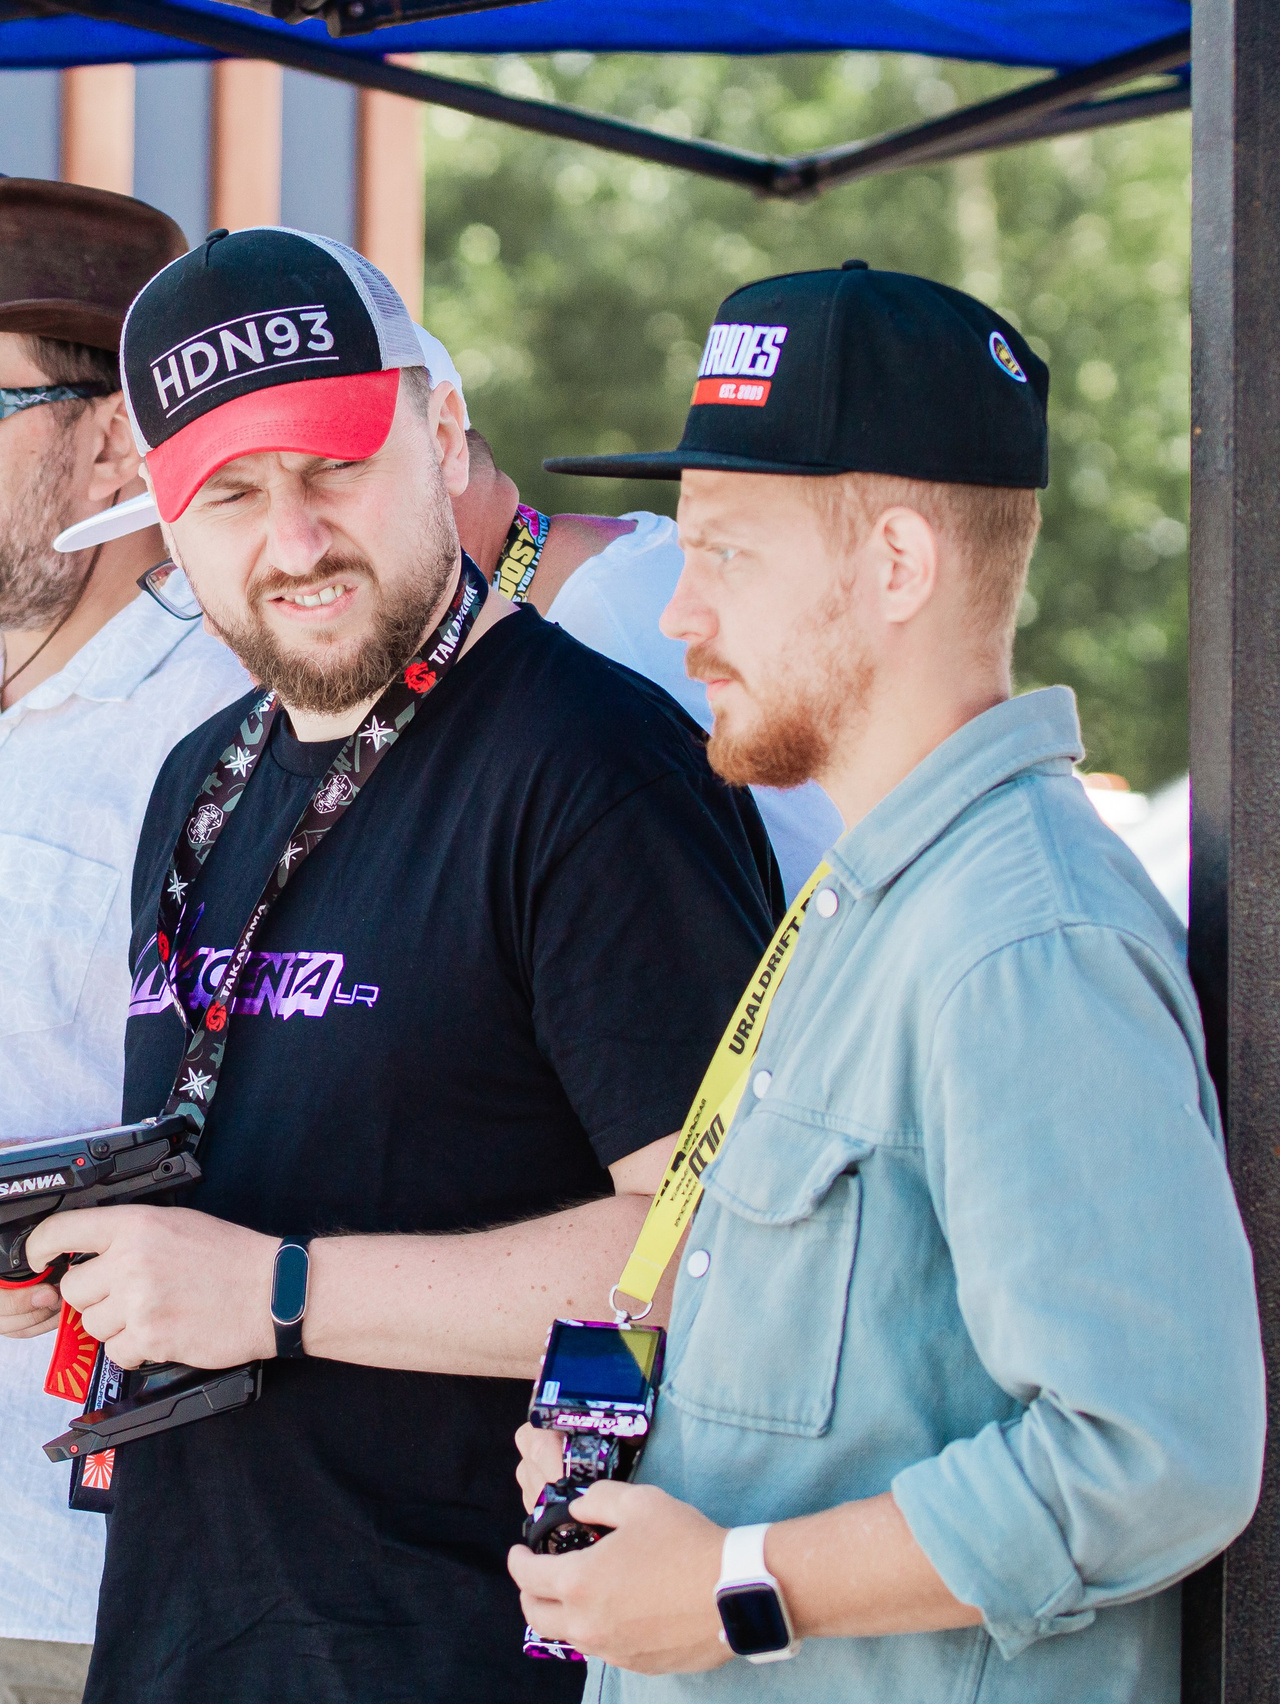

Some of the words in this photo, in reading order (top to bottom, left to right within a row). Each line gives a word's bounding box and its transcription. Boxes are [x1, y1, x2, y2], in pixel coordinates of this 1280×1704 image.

[152, 311, 335, 410] HDN93
[220, 903, 267, 998] TAKAYAMA
[728, 915, 802, 1056] URALDRIFT
